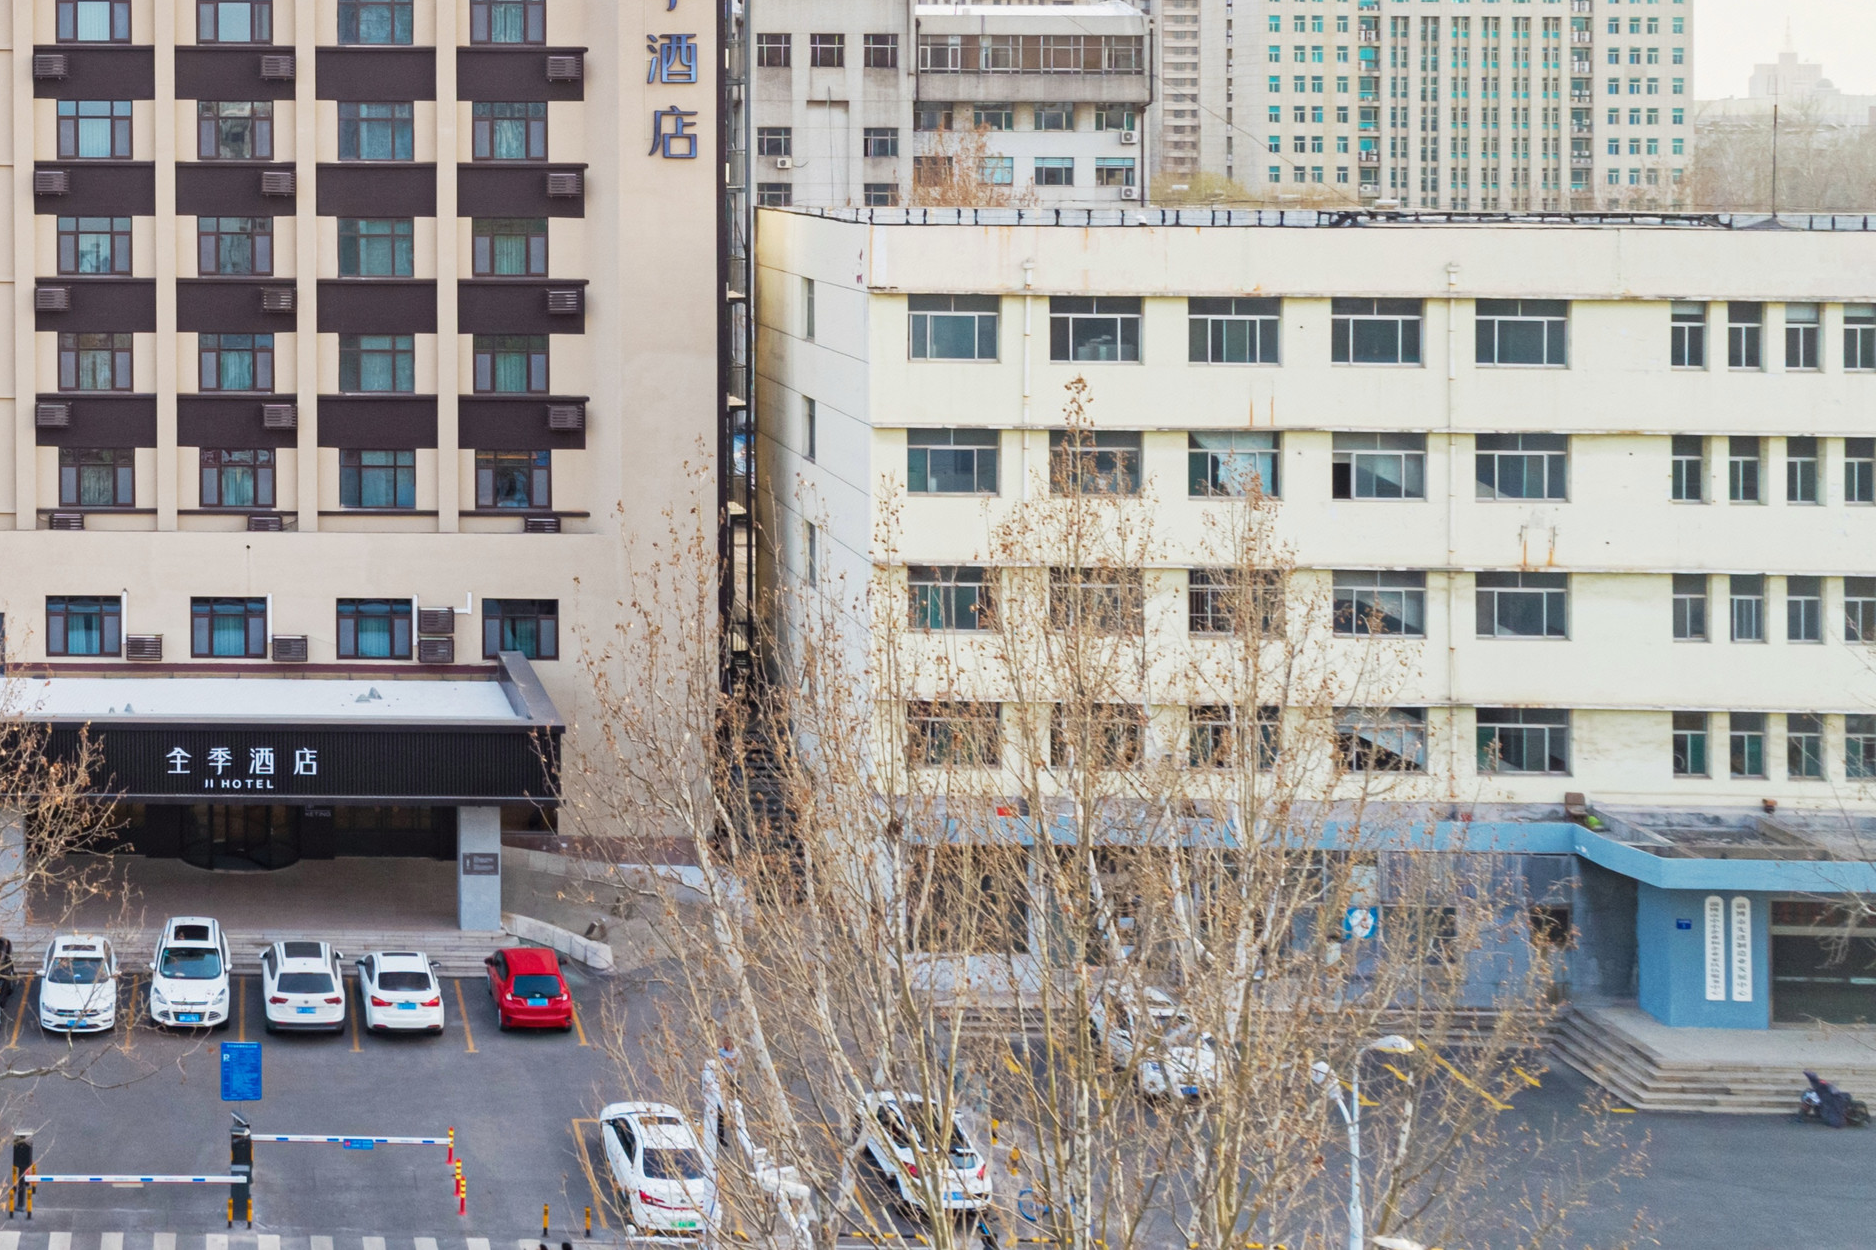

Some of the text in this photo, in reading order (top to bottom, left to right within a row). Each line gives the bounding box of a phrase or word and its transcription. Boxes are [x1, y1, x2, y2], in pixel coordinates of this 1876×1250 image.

[165, 747, 318, 775] 全季酒店
[221, 779, 274, 789] HOTEL
